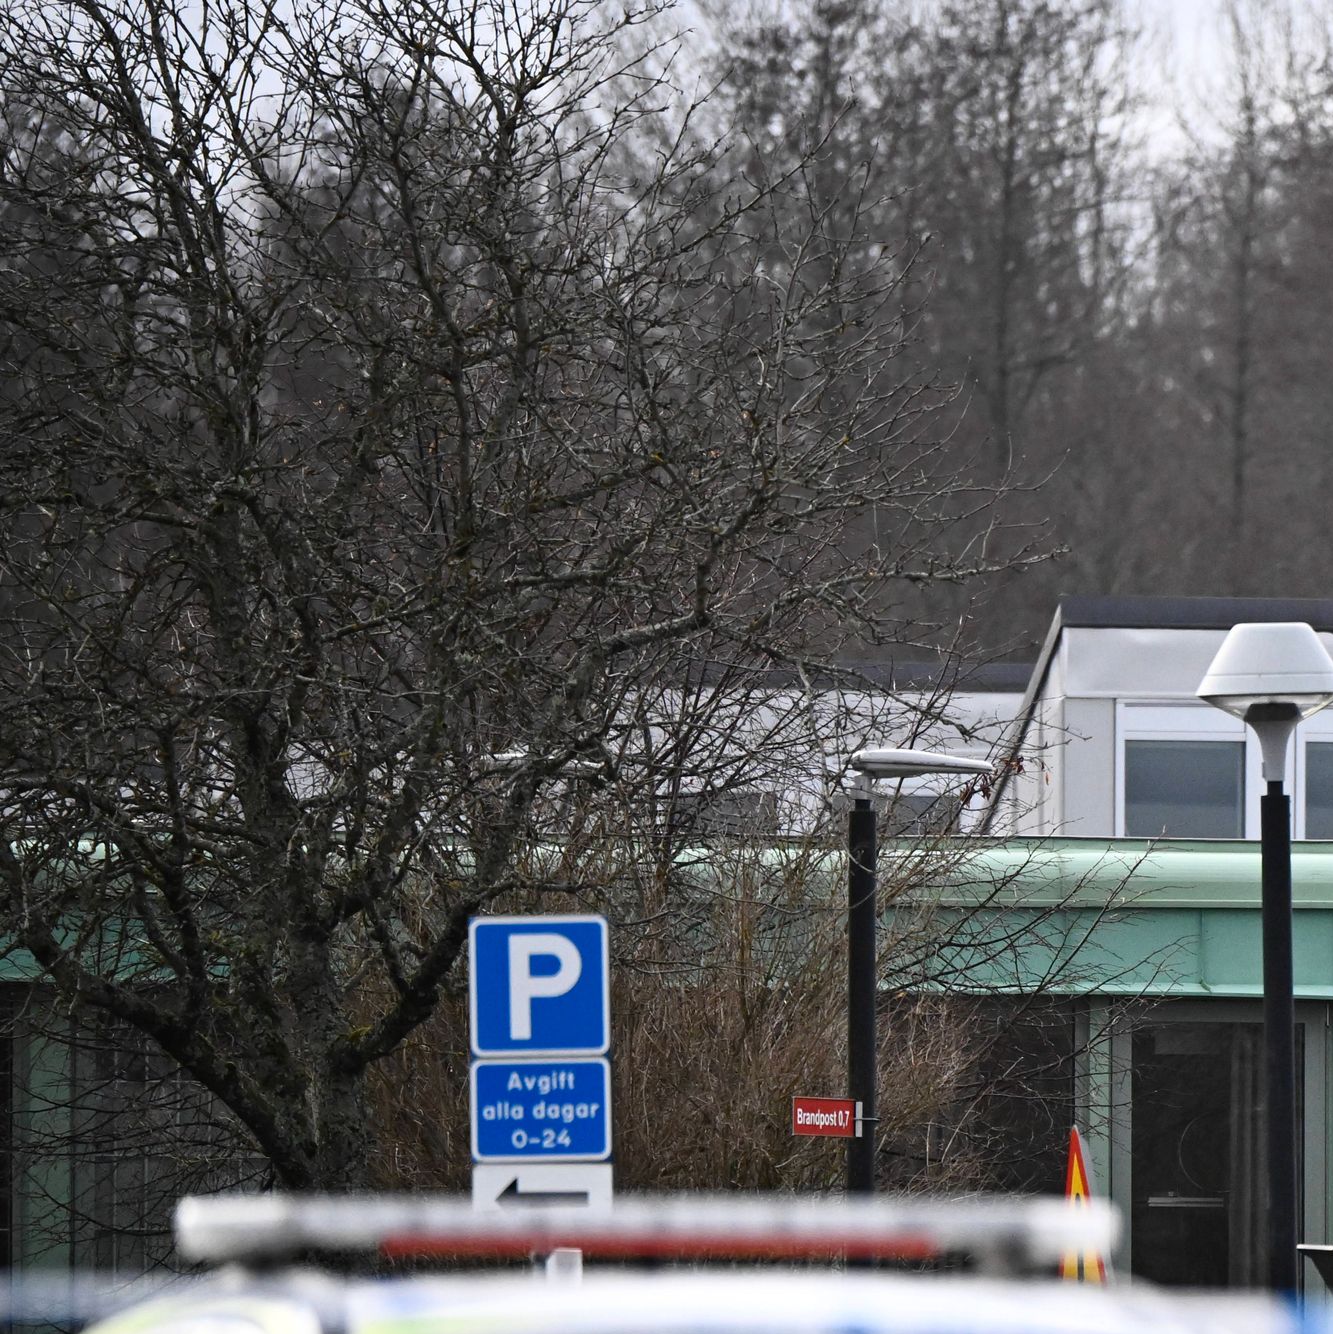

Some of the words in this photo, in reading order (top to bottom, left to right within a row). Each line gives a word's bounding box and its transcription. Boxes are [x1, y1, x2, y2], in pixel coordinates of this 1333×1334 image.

[508, 932, 582, 1041] P
[506, 1071, 575, 1095] Avgift
[482, 1101, 525, 1121] alla
[532, 1100, 600, 1124] dagar
[796, 1107, 837, 1130] Brandpost
[838, 1110, 850, 1129] 0,7
[511, 1128, 572, 1149] 0-24
